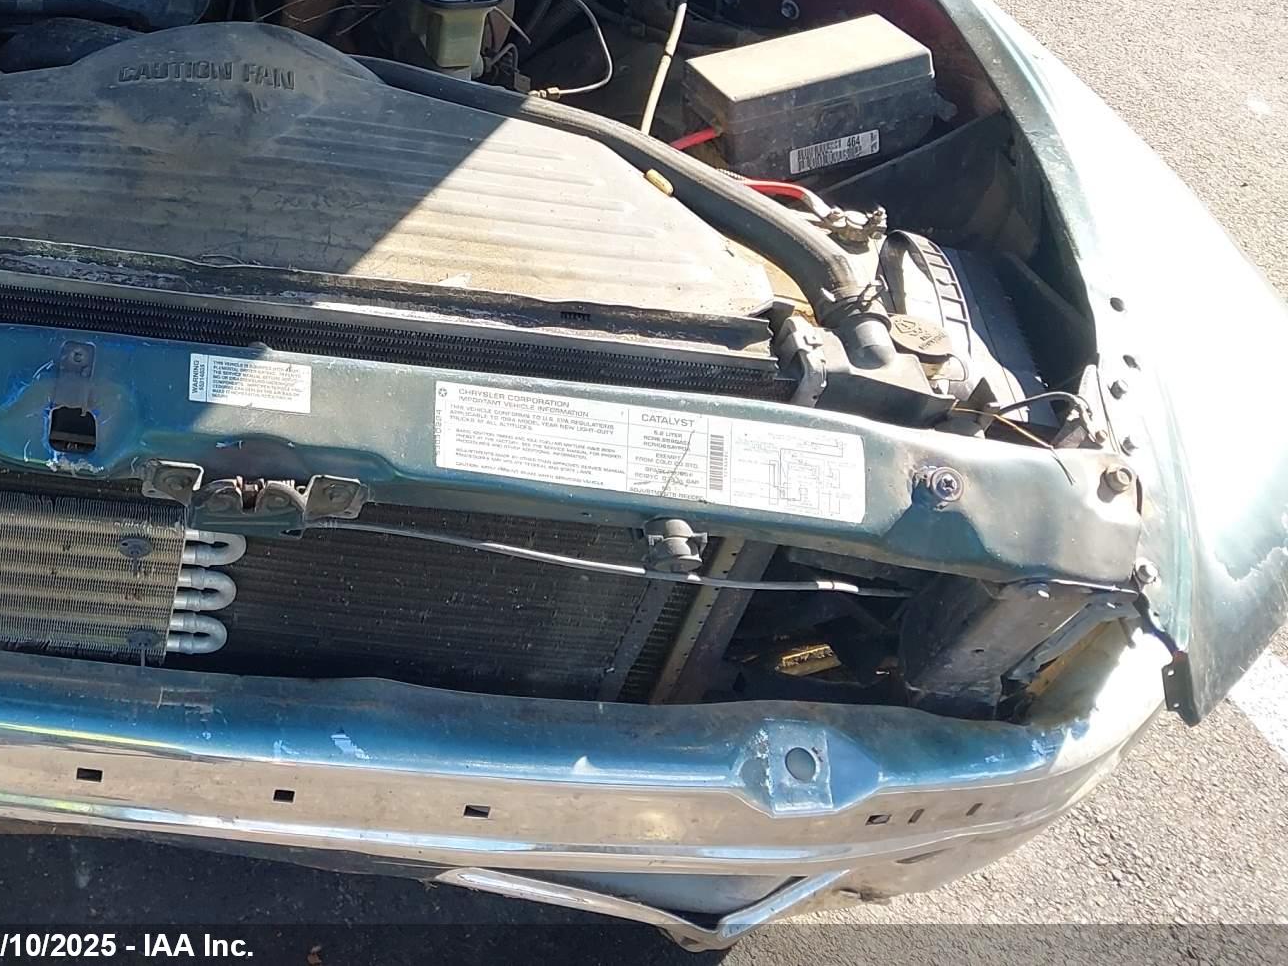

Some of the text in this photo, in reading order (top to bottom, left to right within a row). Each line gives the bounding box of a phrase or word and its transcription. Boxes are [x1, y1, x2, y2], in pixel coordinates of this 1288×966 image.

[119, 61, 295, 90] CAUTION FAN
[847, 136, 860, 147] 464
[458, 388, 570, 408] CHRYSLER CORPORATION
[459, 396, 589, 417] IMPORTANT VEHICLE INFORMATION
[450, 410, 487, 418] APPLICABLE
[518, 418, 540, 426] MODEL
[576, 426, 614, 435] LIGHT-DUTY
[466, 406, 491, 414] VEHICLE
[494, 409, 530, 418] CONFORMS
[570, 420, 614, 430] REGULATIONS
[641, 414, 695, 427] CATALYST
